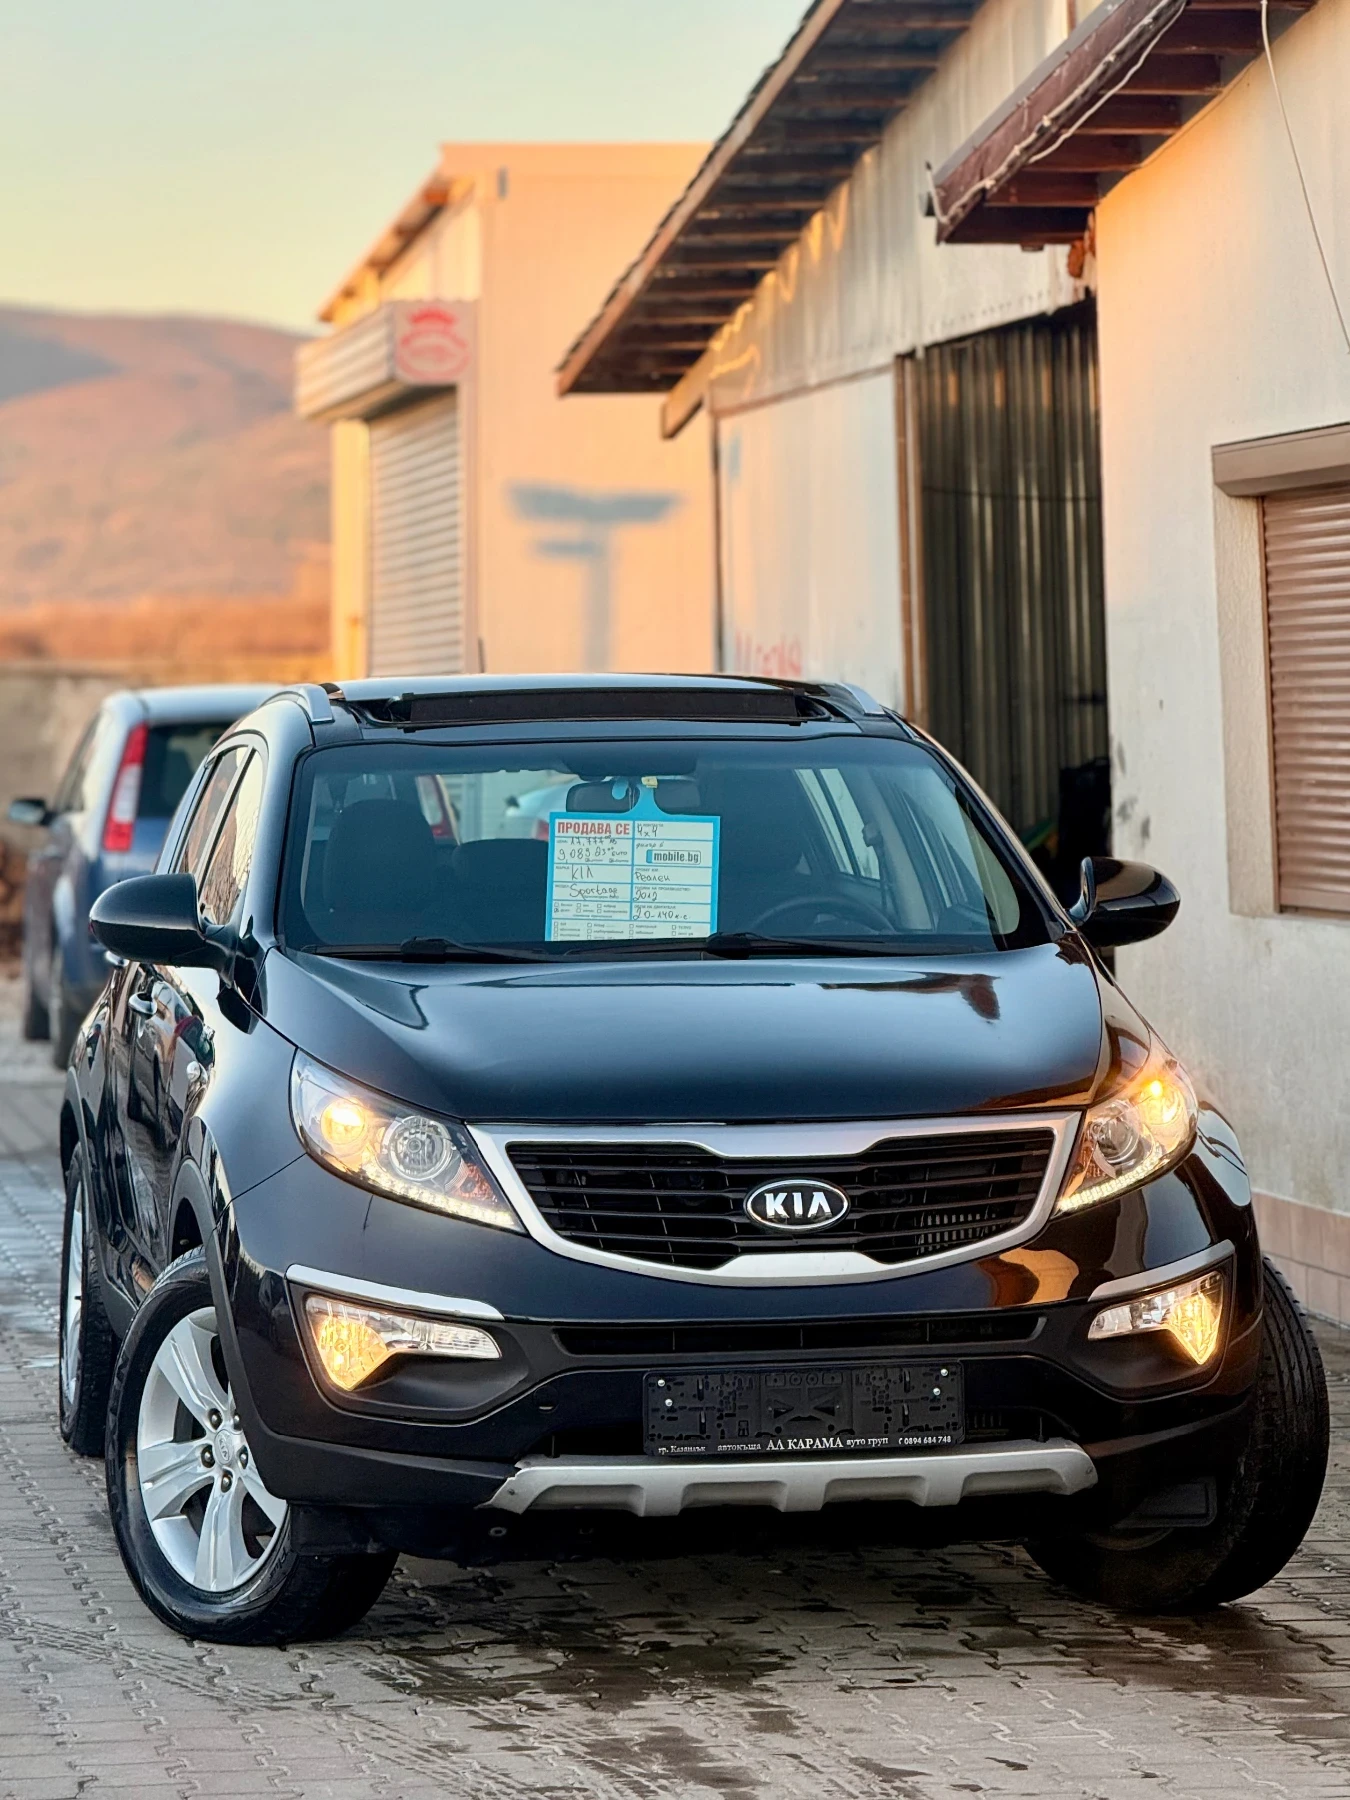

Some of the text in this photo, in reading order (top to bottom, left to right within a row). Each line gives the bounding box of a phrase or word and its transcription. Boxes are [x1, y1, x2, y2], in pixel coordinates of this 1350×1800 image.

[557, 822, 630, 835] ПРОДАВА СЕ
[653, 851, 699, 863] mobile.bg
[569, 883, 618, 900] Sportage
[632, 890, 658, 902] 2012
[764, 1191, 833, 1219] KIA
[658, 1447, 669, 1455] гр.
[766, 1439, 785, 1450] АЛ
[787, 1437, 844, 1450] КАРАМА
[904, 1437, 922, 1445] 0894
[938, 1435, 952, 1443] 748
